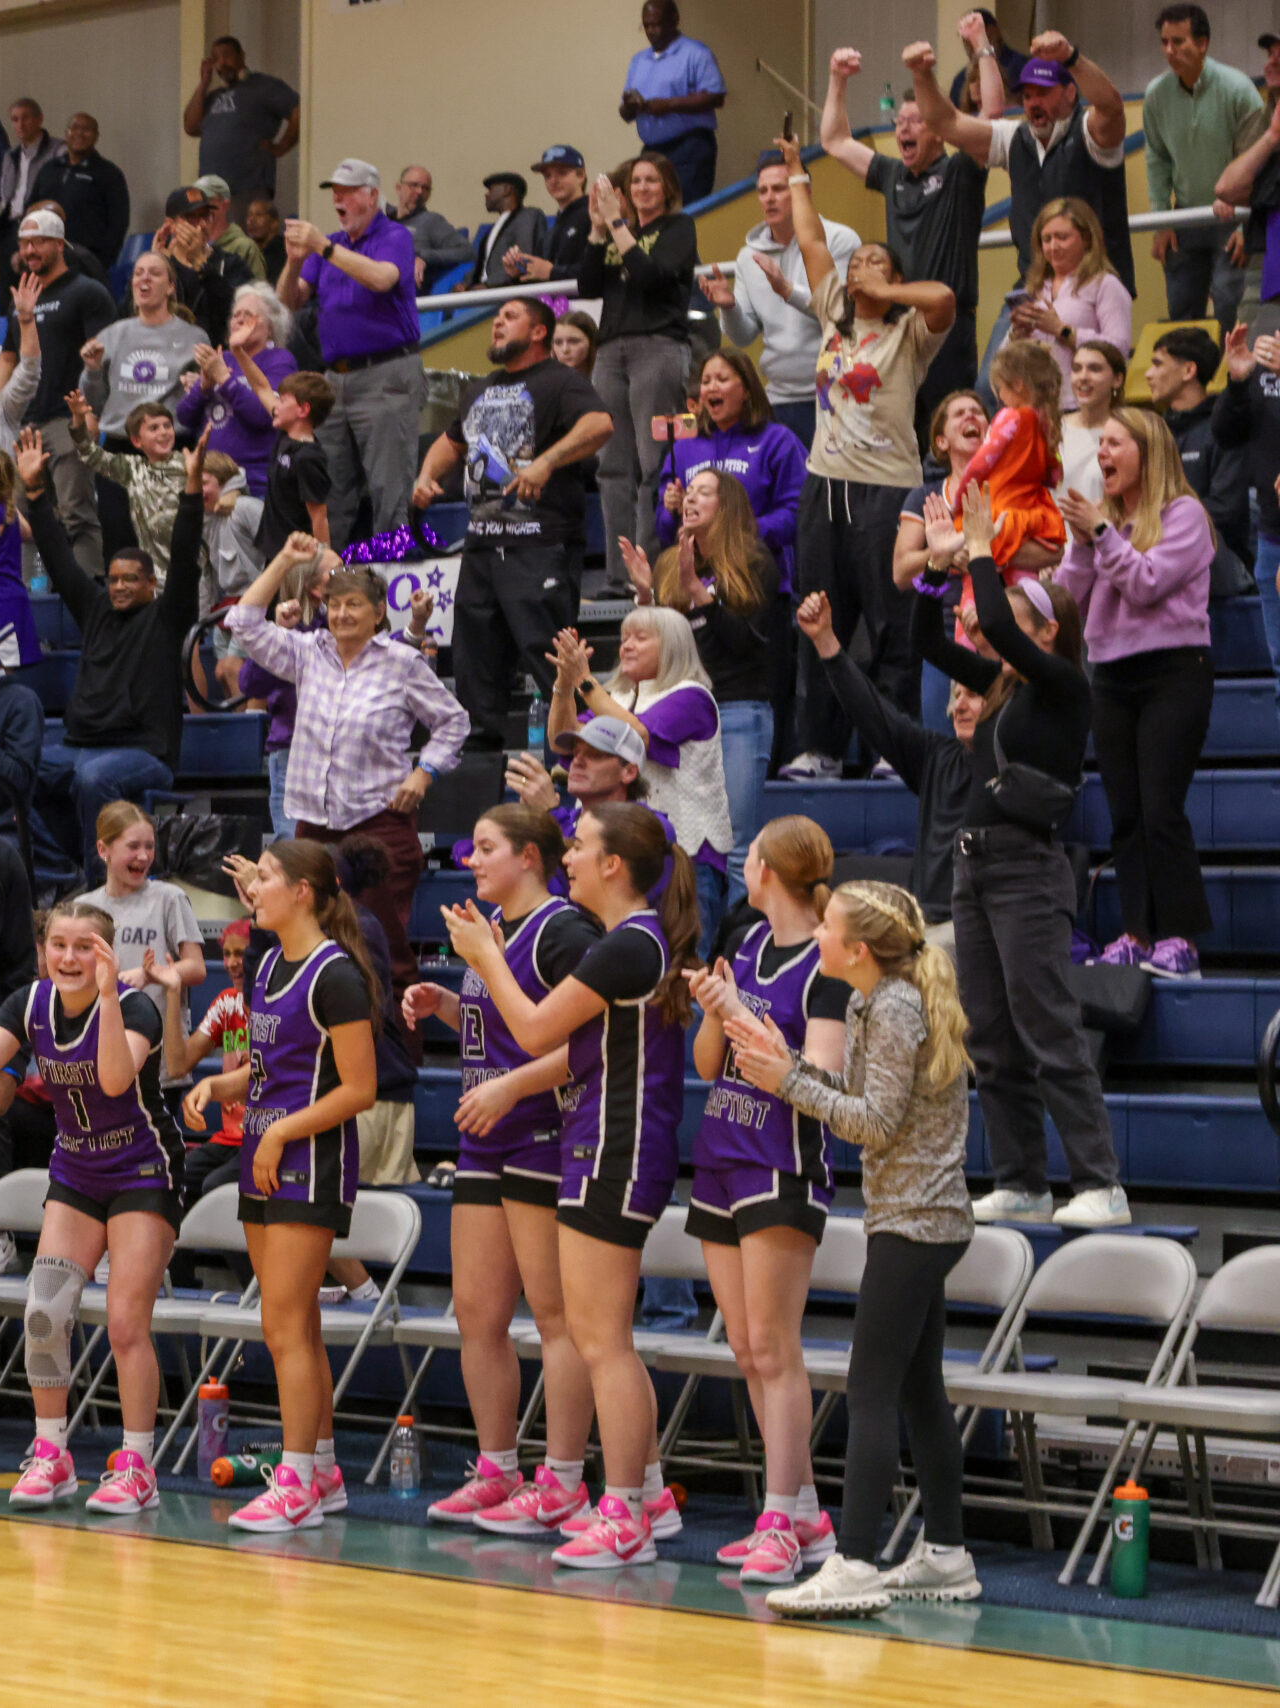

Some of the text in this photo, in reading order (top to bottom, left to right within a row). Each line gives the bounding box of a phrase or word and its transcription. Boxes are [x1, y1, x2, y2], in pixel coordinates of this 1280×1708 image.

[121, 926, 157, 945] GAP
[461, 1003, 486, 1060] 13
[39, 1056, 95, 1086] FIRST
[68, 1088, 91, 1132] 1
